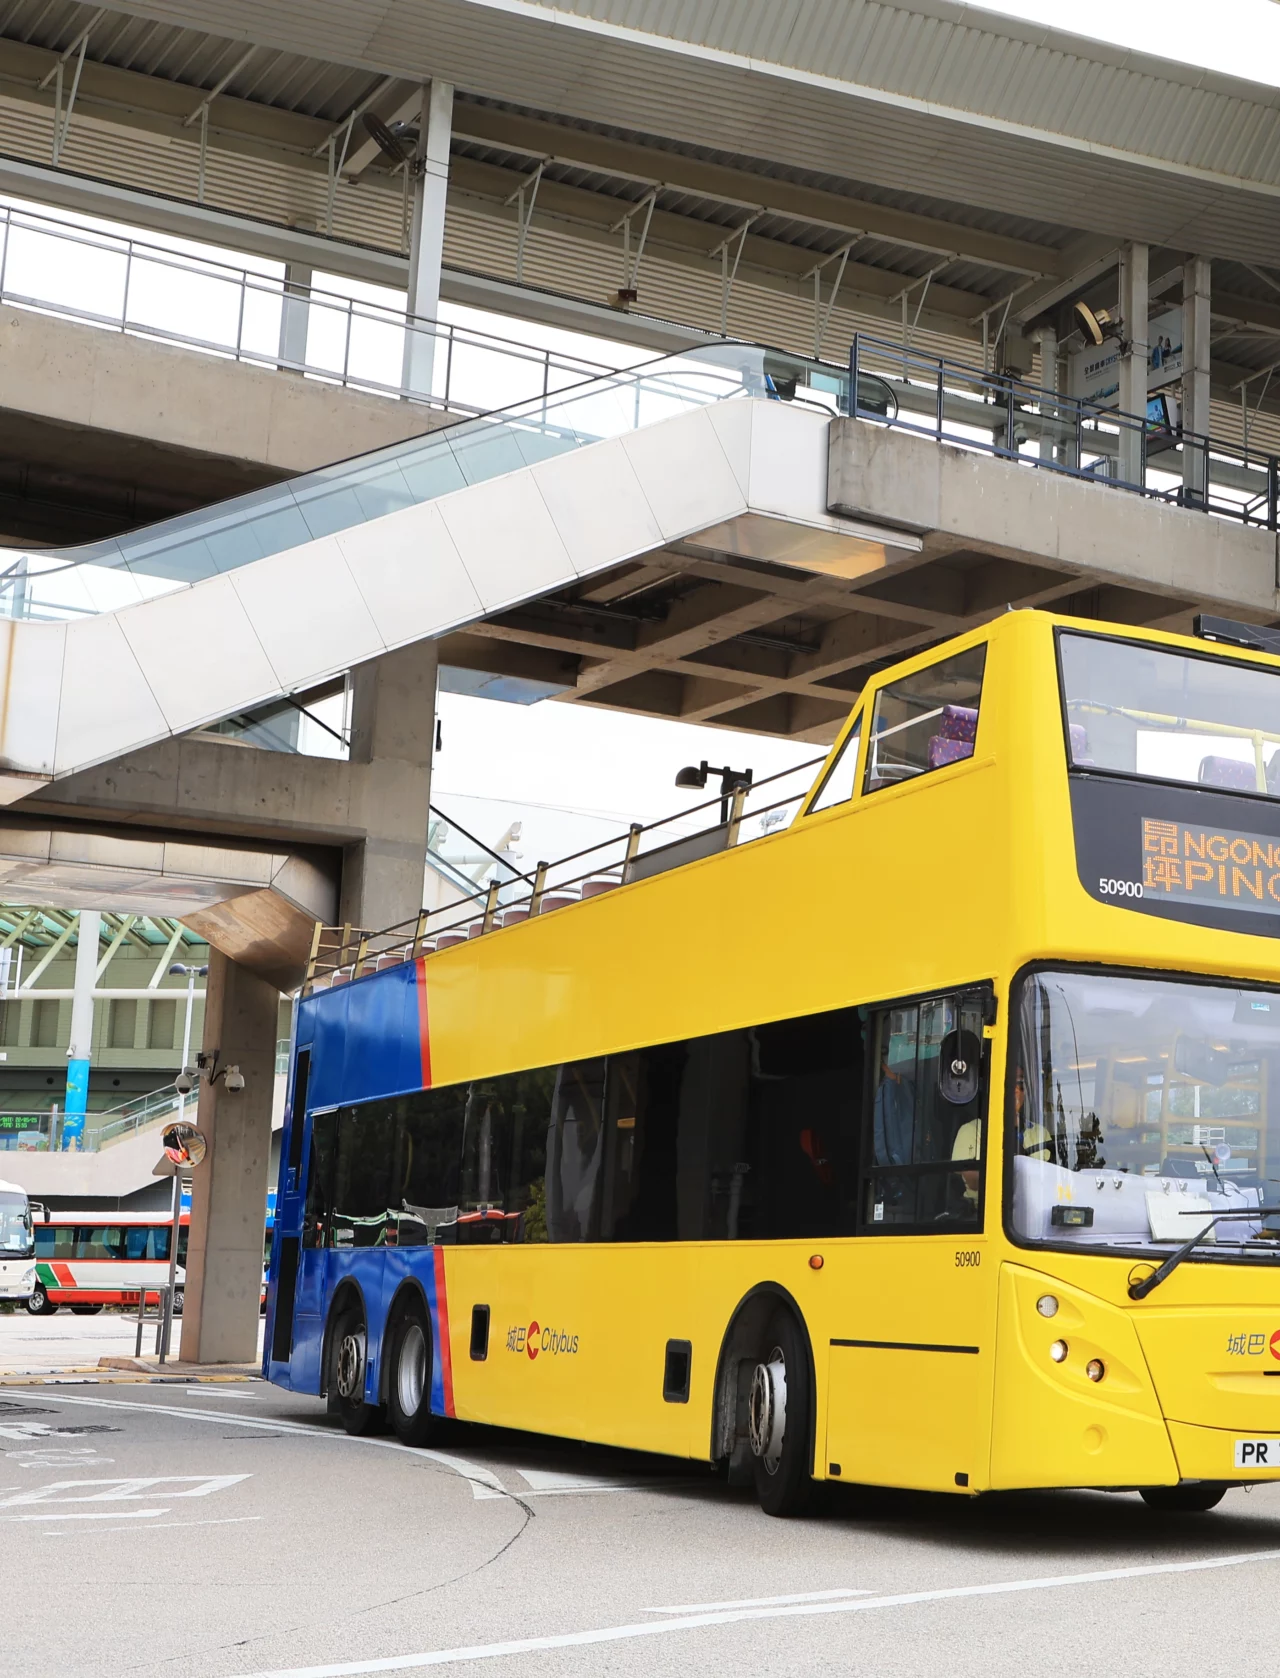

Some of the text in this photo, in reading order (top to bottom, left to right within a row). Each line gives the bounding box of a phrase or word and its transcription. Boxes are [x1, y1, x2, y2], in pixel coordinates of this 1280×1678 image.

[1099, 878, 1144, 898] 50900
[955, 1251, 981, 1268] 50900
[506, 1325, 527, 1353] 城巴
[541, 1327, 580, 1356] Citybus
[1226, 1333, 1266, 1356] 城巴
[1241, 1442, 1268, 1464] PR
